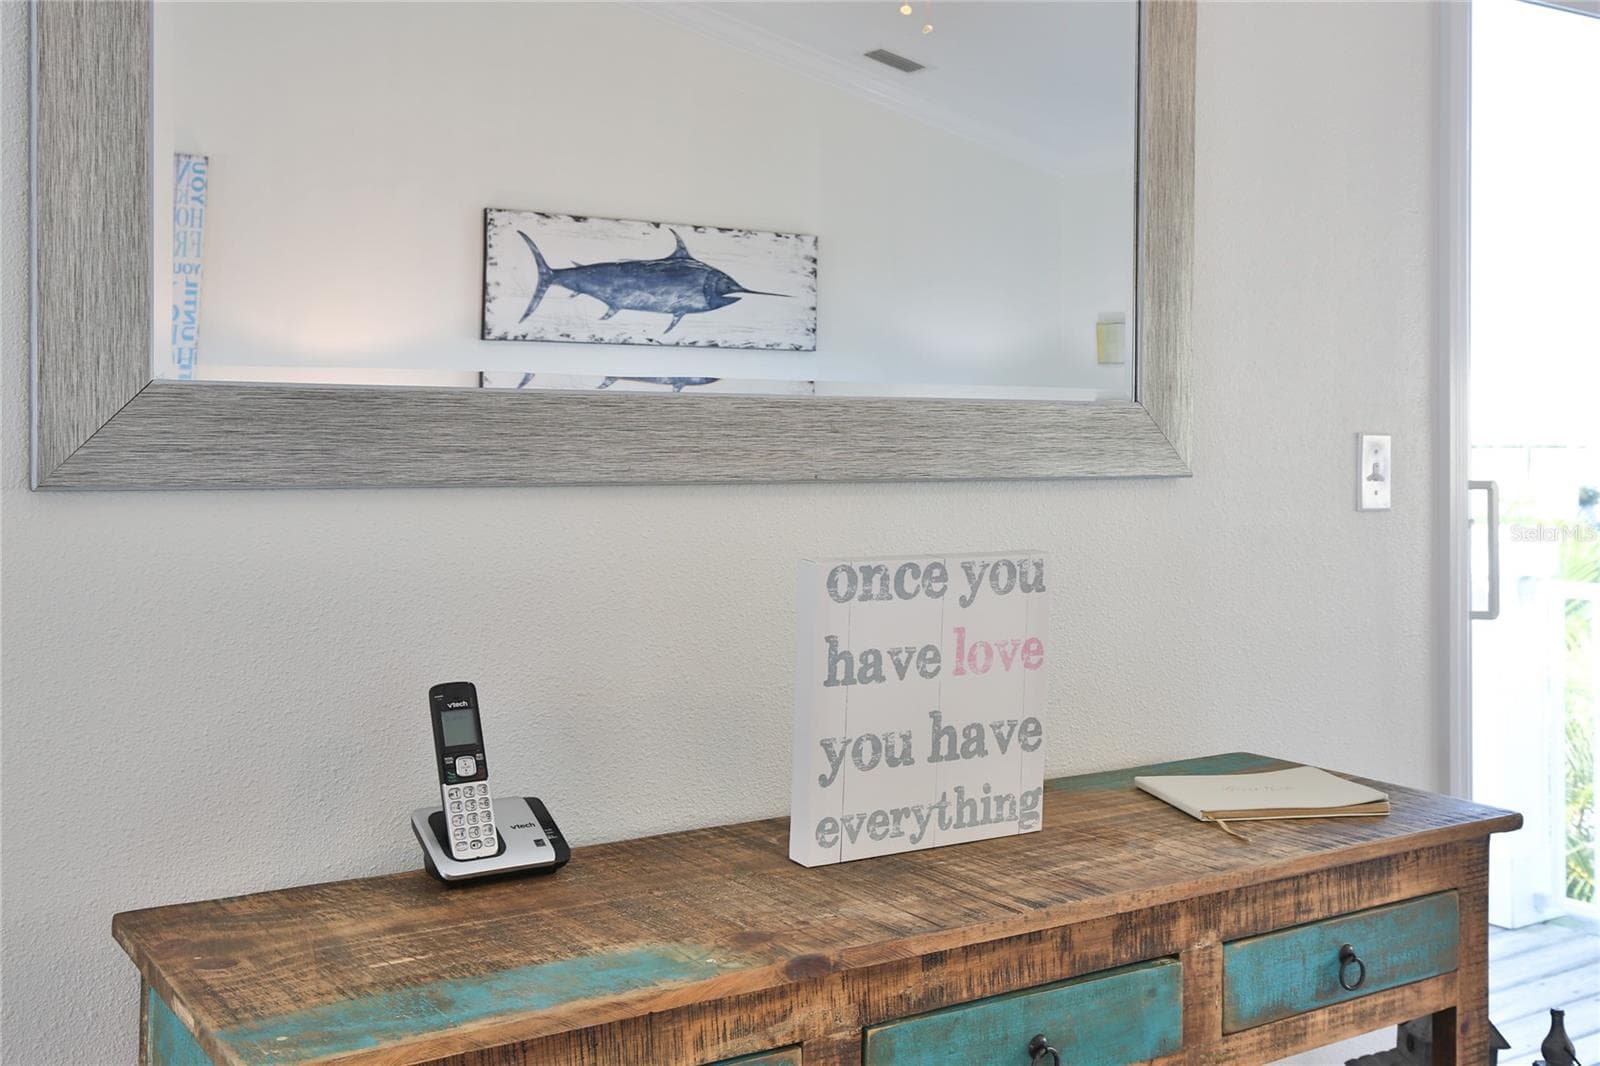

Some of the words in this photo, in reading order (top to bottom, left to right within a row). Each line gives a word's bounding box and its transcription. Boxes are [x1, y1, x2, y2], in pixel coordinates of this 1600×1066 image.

[825, 561, 949, 604] once
[958, 558, 1047, 609] you
[823, 634, 942, 688] have
[952, 626, 1045, 676] love
[818, 730, 915, 789] you
[927, 710, 1043, 764] have
[815, 782, 1043, 849] everything
